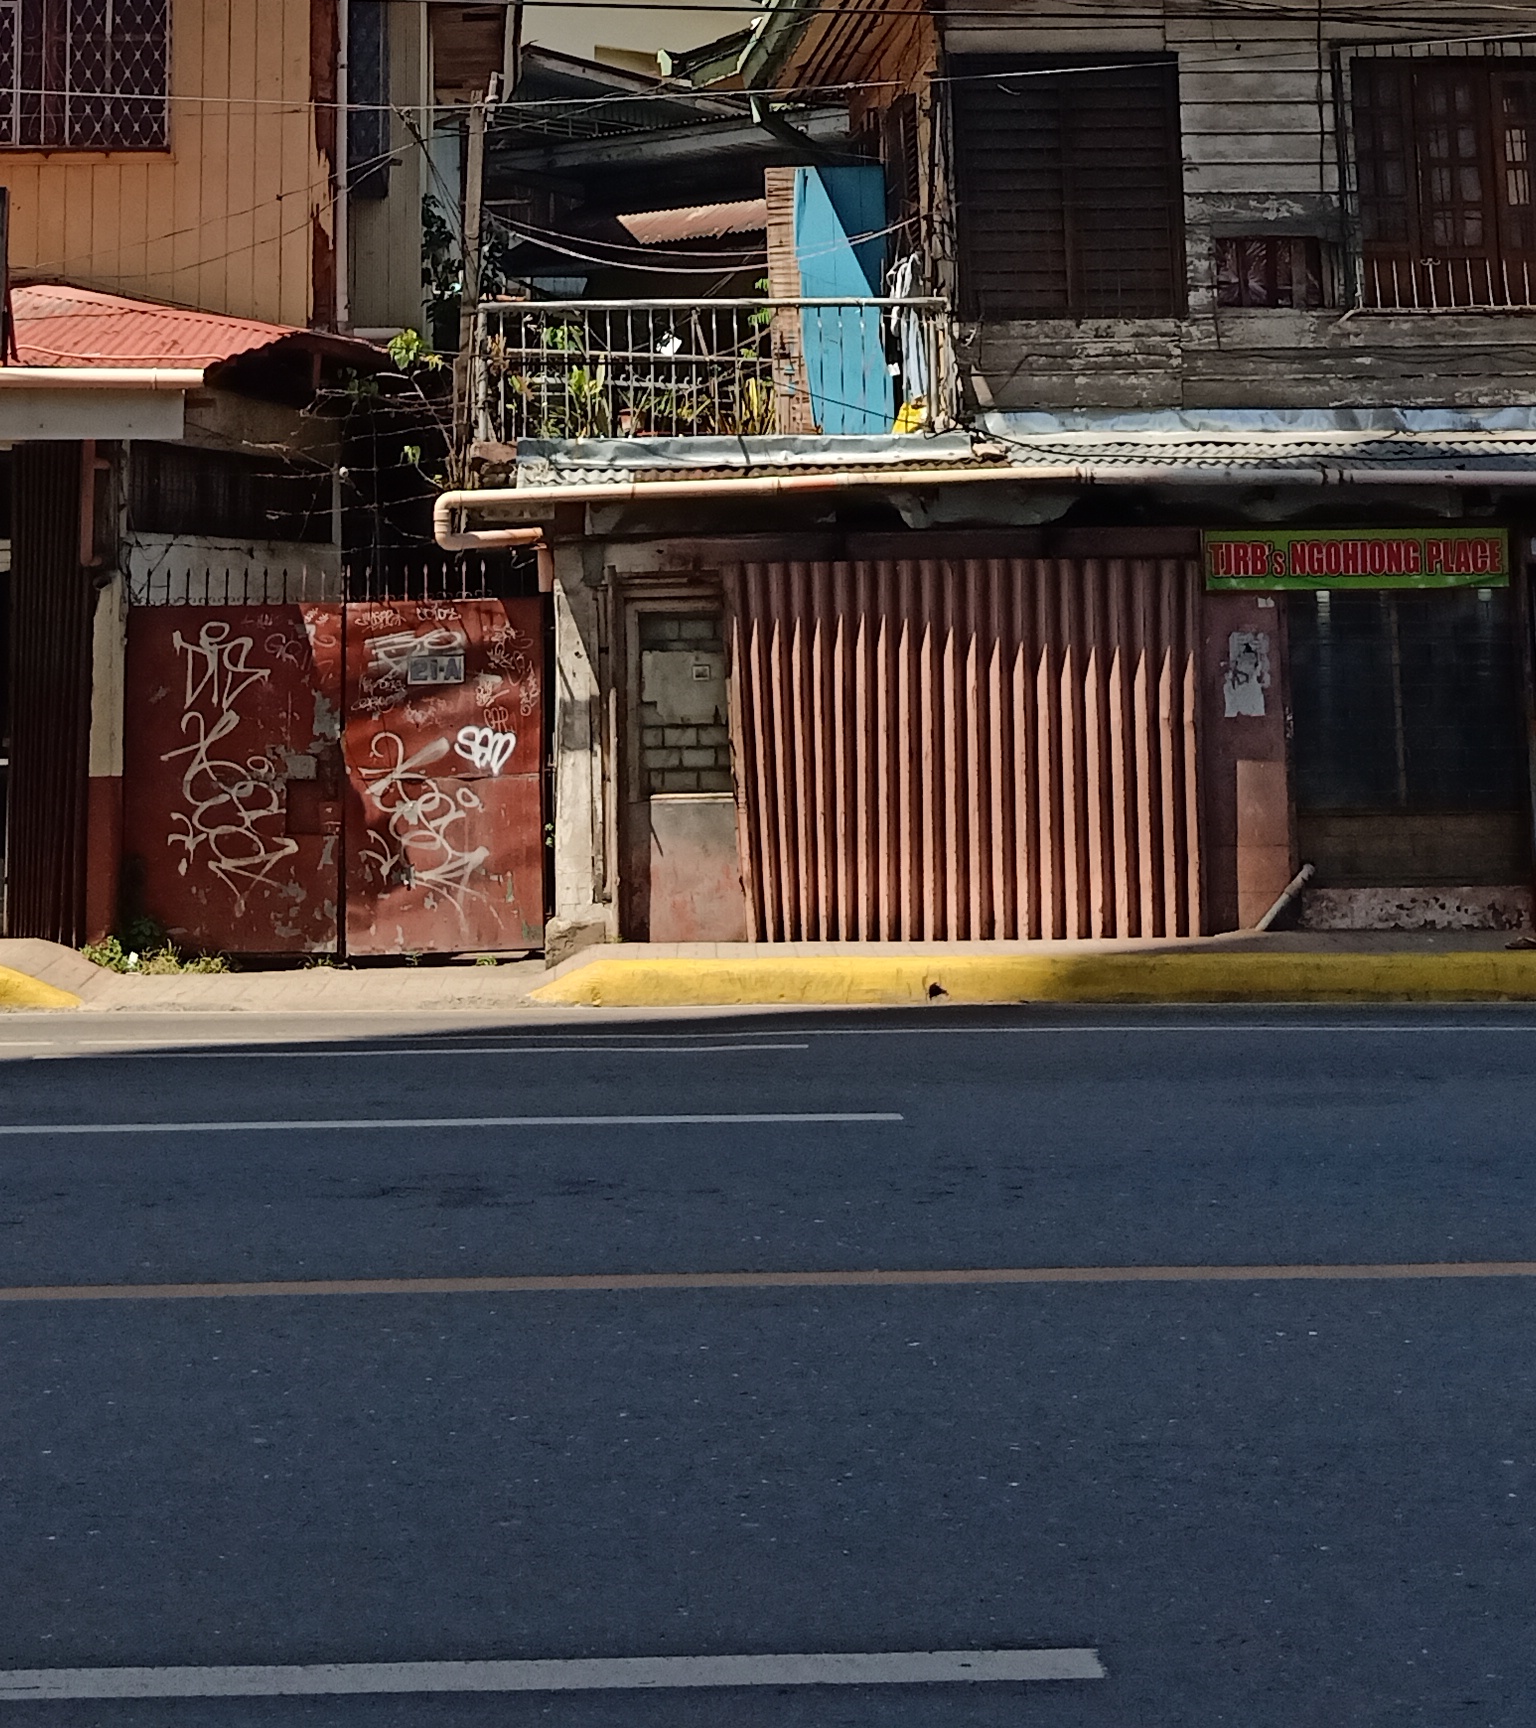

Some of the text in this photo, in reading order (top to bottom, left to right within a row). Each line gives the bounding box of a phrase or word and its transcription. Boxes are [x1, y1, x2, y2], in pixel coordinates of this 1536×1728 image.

[1289, 539, 1421, 576] NGOHIONG
[1426, 537, 1503, 575] PLACE
[409, 658, 463, 682] 21-A
